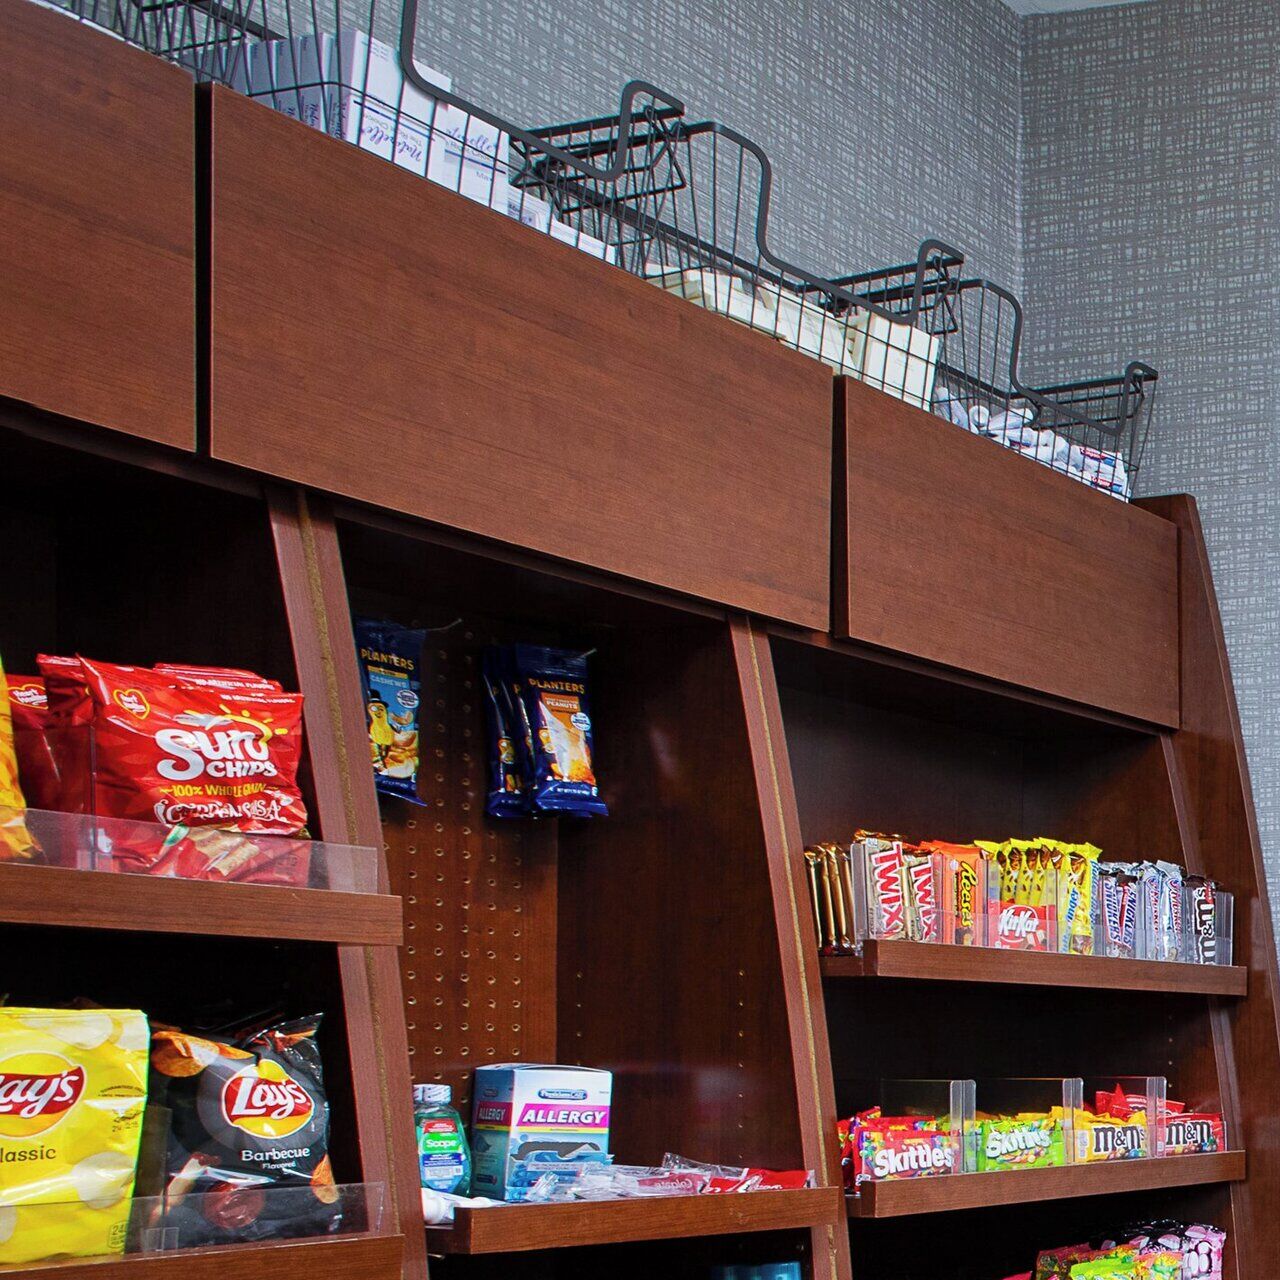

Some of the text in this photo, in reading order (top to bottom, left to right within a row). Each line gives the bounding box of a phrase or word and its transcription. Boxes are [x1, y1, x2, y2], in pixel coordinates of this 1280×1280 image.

[361, 648, 415, 672] PLANTERS
[529, 677, 586, 695] PLANTERS
[156, 728, 270, 781] Sun
[207, 758, 278, 779] CHIPS
[172, 783, 203, 798] 100%
[871, 841, 904, 938] TWIX
[909, 854, 935, 941] TWIX
[0, 1071, 75, 1118] ay's
[231, 1077, 309, 1119] Lay's
[479, 1107, 507, 1123] ALLERGY
[523, 1109, 607, 1126] ALLERGY
[0, 1146, 57, 1170] lassic
[241, 1145, 310, 1163] Barbecue
[261, 1160, 297, 1172] Flavored
[873, 1146, 954, 1178] Skittles
